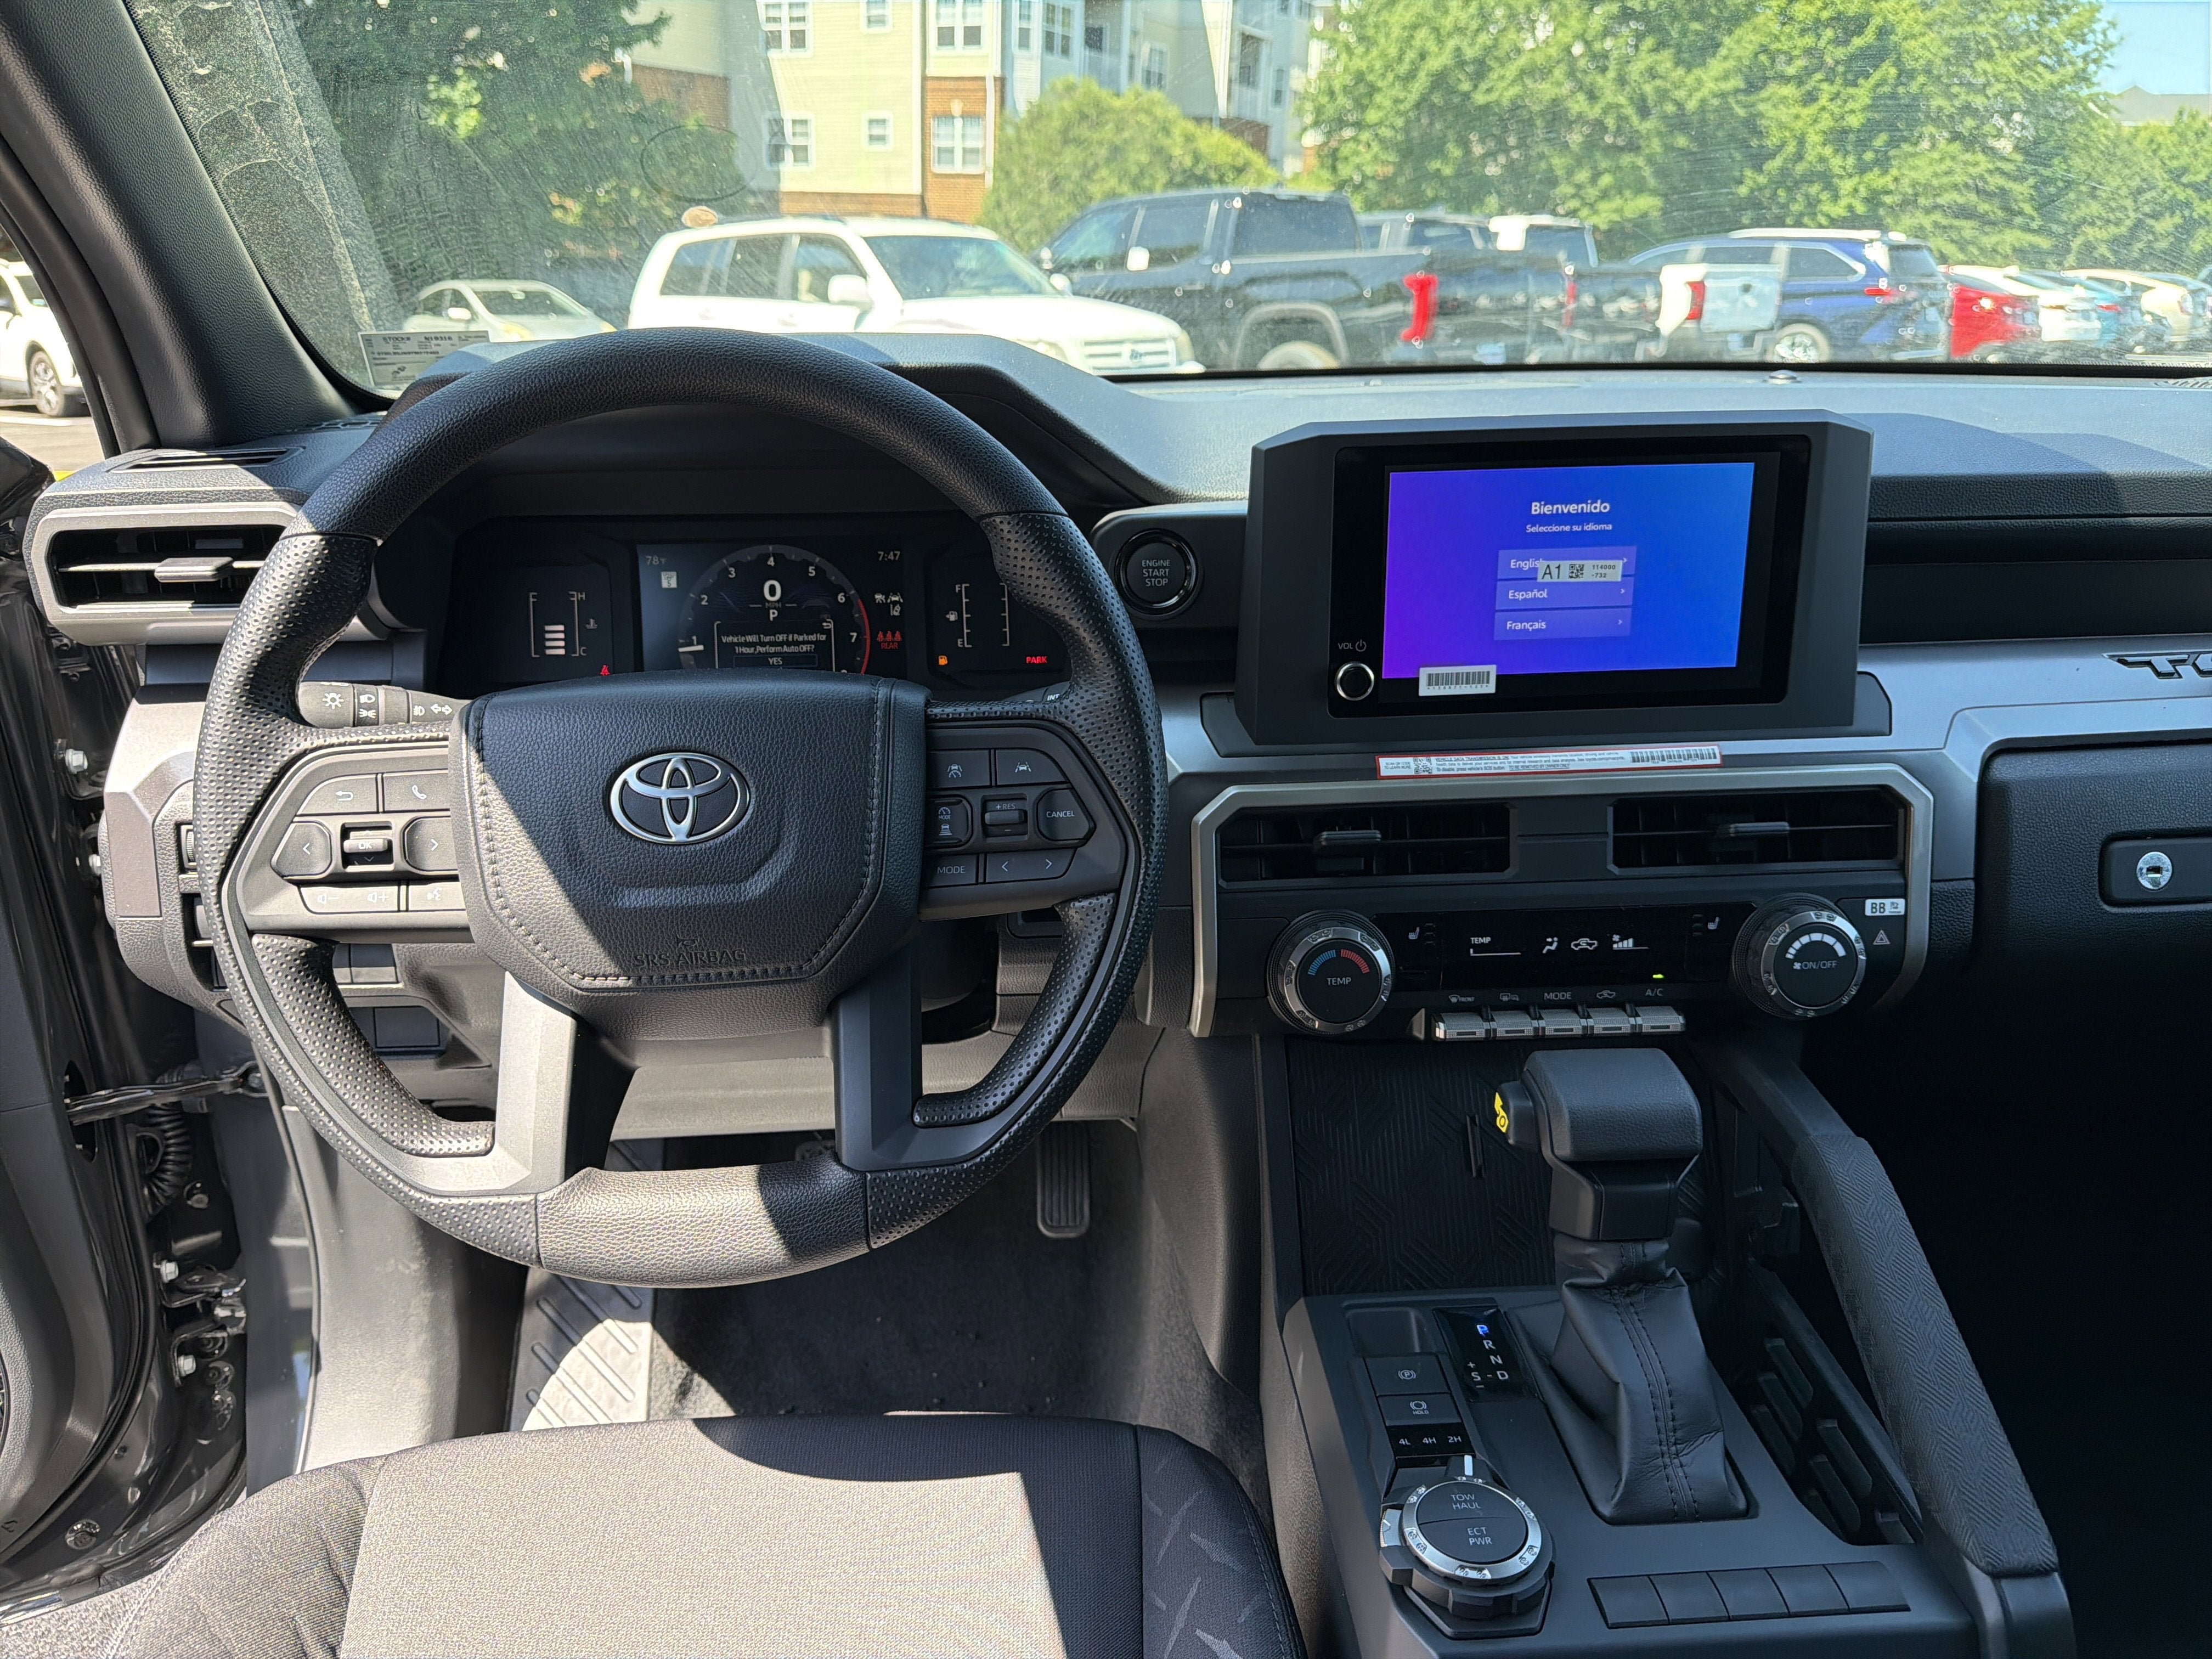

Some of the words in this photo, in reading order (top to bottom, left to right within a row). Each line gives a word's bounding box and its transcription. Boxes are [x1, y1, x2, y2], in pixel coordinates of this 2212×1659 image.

[1531, 499, 1611, 515] Bienvenido
[1526, 524, 1570, 533] Seleccione
[1583, 523, 1612, 531] idioma
[768, 556, 775, 566] 4
[878, 551, 900, 561] 7:47
[728, 567, 736, 578] 3
[808, 566, 816, 577] 5
[1143, 568, 1170, 577] START
[1541, 563, 1562, 580] A1
[1146, 578, 1169, 587] STOP
[763, 580, 781, 601] 0
[955, 584, 961, 593] F
[578, 592, 585, 600] H
[701, 595, 708, 605] 2
[838, 593, 845, 603] 6
[1508, 589, 1548, 601] Español
[770, 610, 778, 621] P
[1506, 619, 1547, 631] Français
[721, 635, 745, 643] Vehicle
[850, 633, 857, 642] 7
[957, 639, 963, 647] E
[580, 647, 586, 656] C
[358, 841, 372, 850] OK
[937, 866, 966, 874] MODE
[1871, 902, 1886, 914] BB
[634, 953, 670, 967] SRS
[678, 948, 747, 966] AIRBAG
[1802, 960, 1838, 969] ON/OFF
[1327, 977, 1352, 985] TEMP
[1544, 992, 1573, 1000] MODE
[1645, 988, 1663, 997] A/C
[1476, 1324, 1489, 1335] P
[1482, 1339, 1496, 1351] R
[1489, 1355, 1503, 1365] N
[1471, 1372, 1481, 1381] S
[1496, 1370, 1509, 1380] D
[1467, 1527, 1488, 1536] ECT
[1469, 1537, 1493, 1546] PWR
